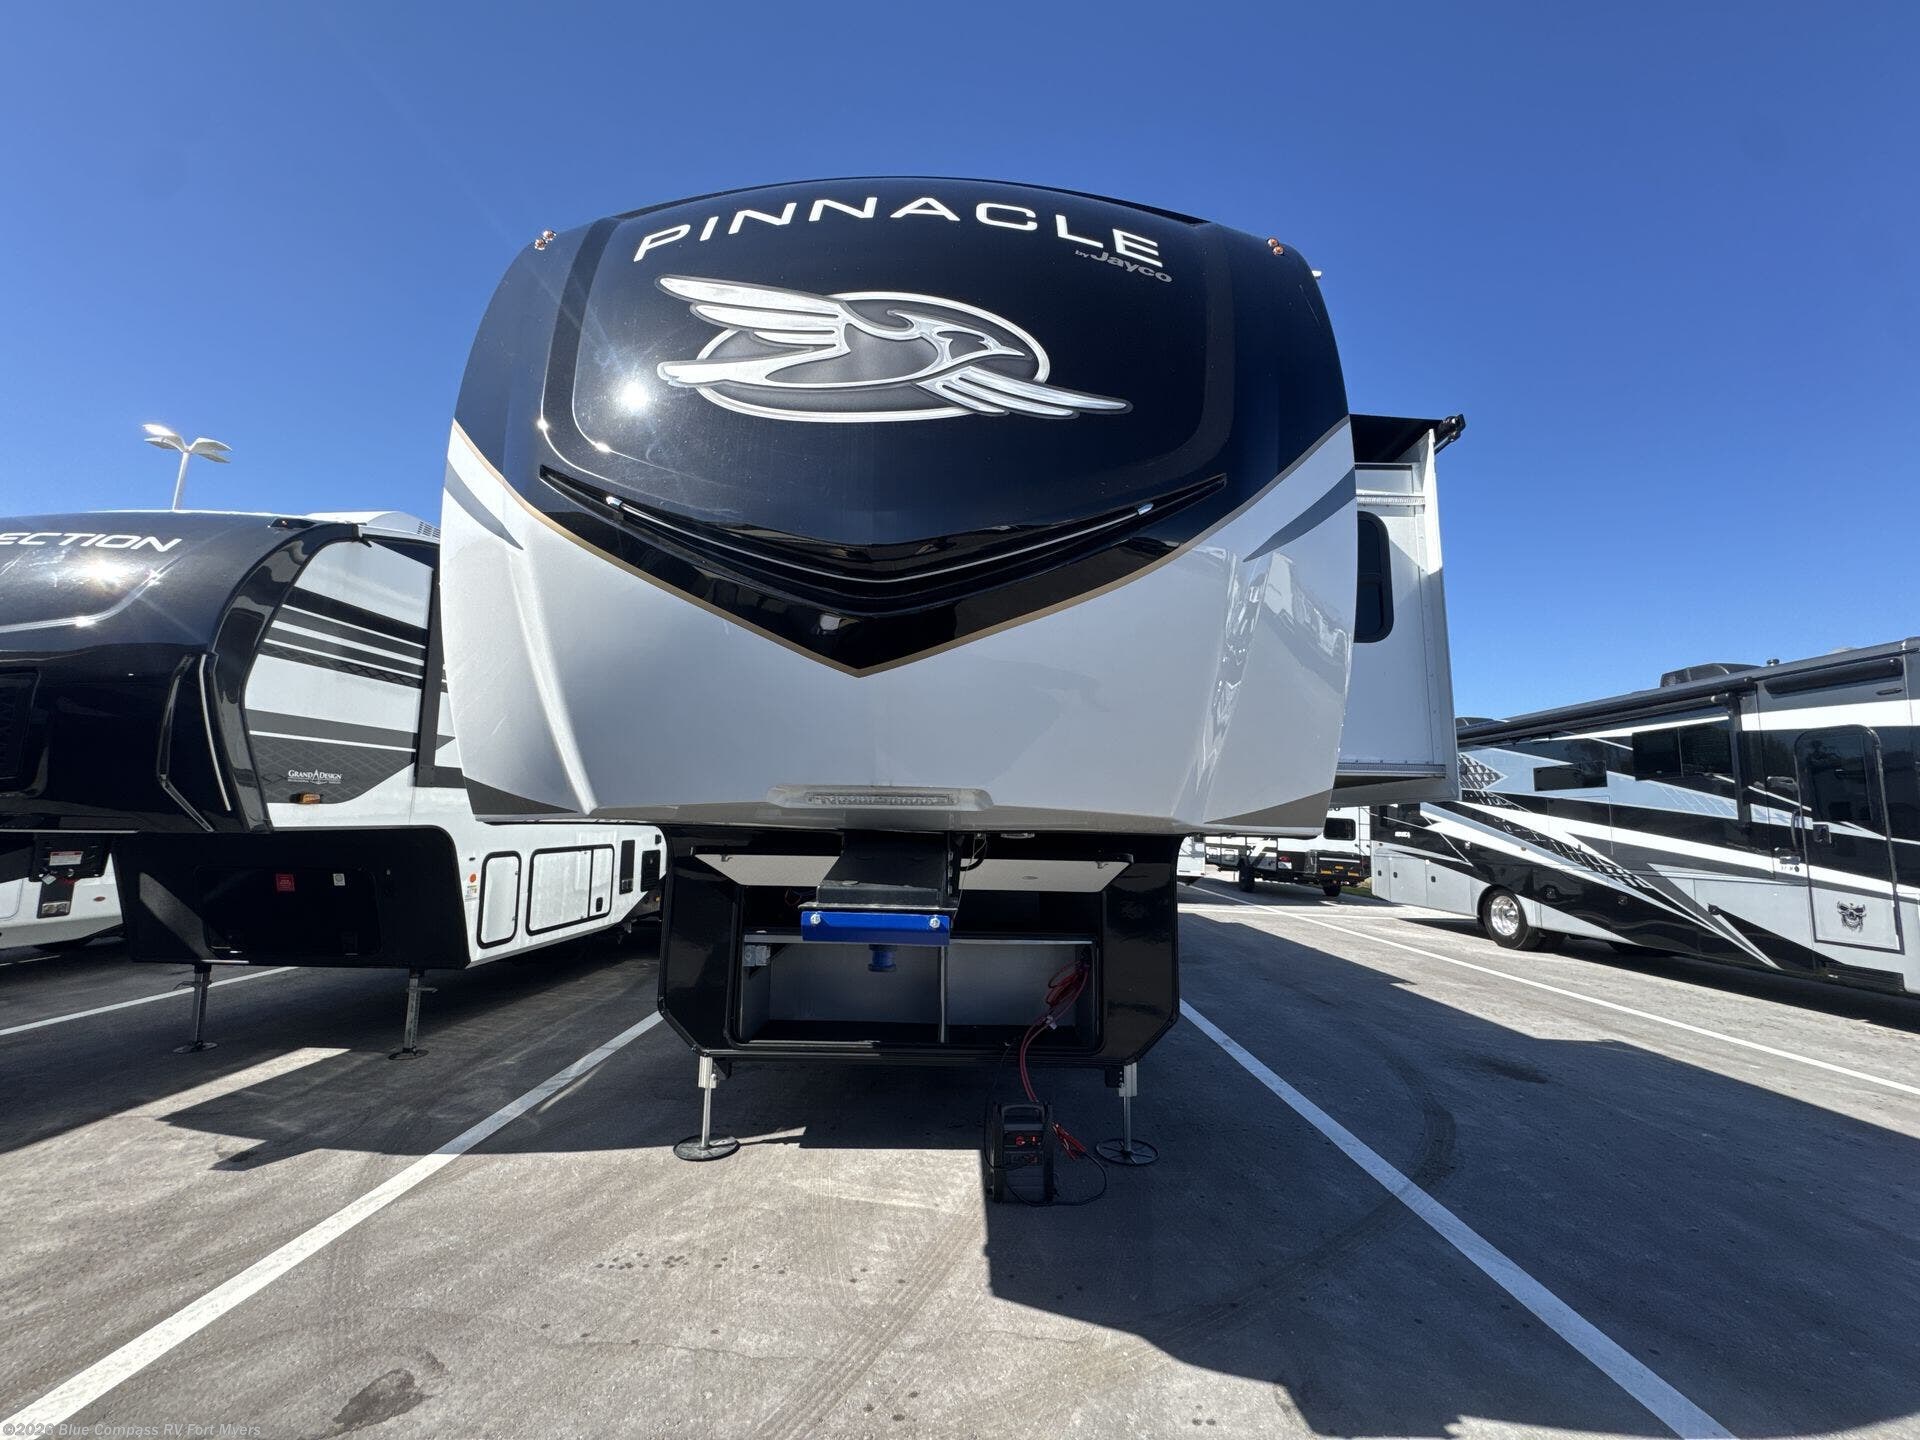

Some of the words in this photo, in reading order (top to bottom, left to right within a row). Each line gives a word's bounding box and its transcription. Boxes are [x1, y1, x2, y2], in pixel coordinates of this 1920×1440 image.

[633, 196, 1163, 268] PINNACLE
[1074, 249, 1090, 258] by
[1090, 251, 1173, 283] Jayco
[0, 532, 183, 553] ECTION
